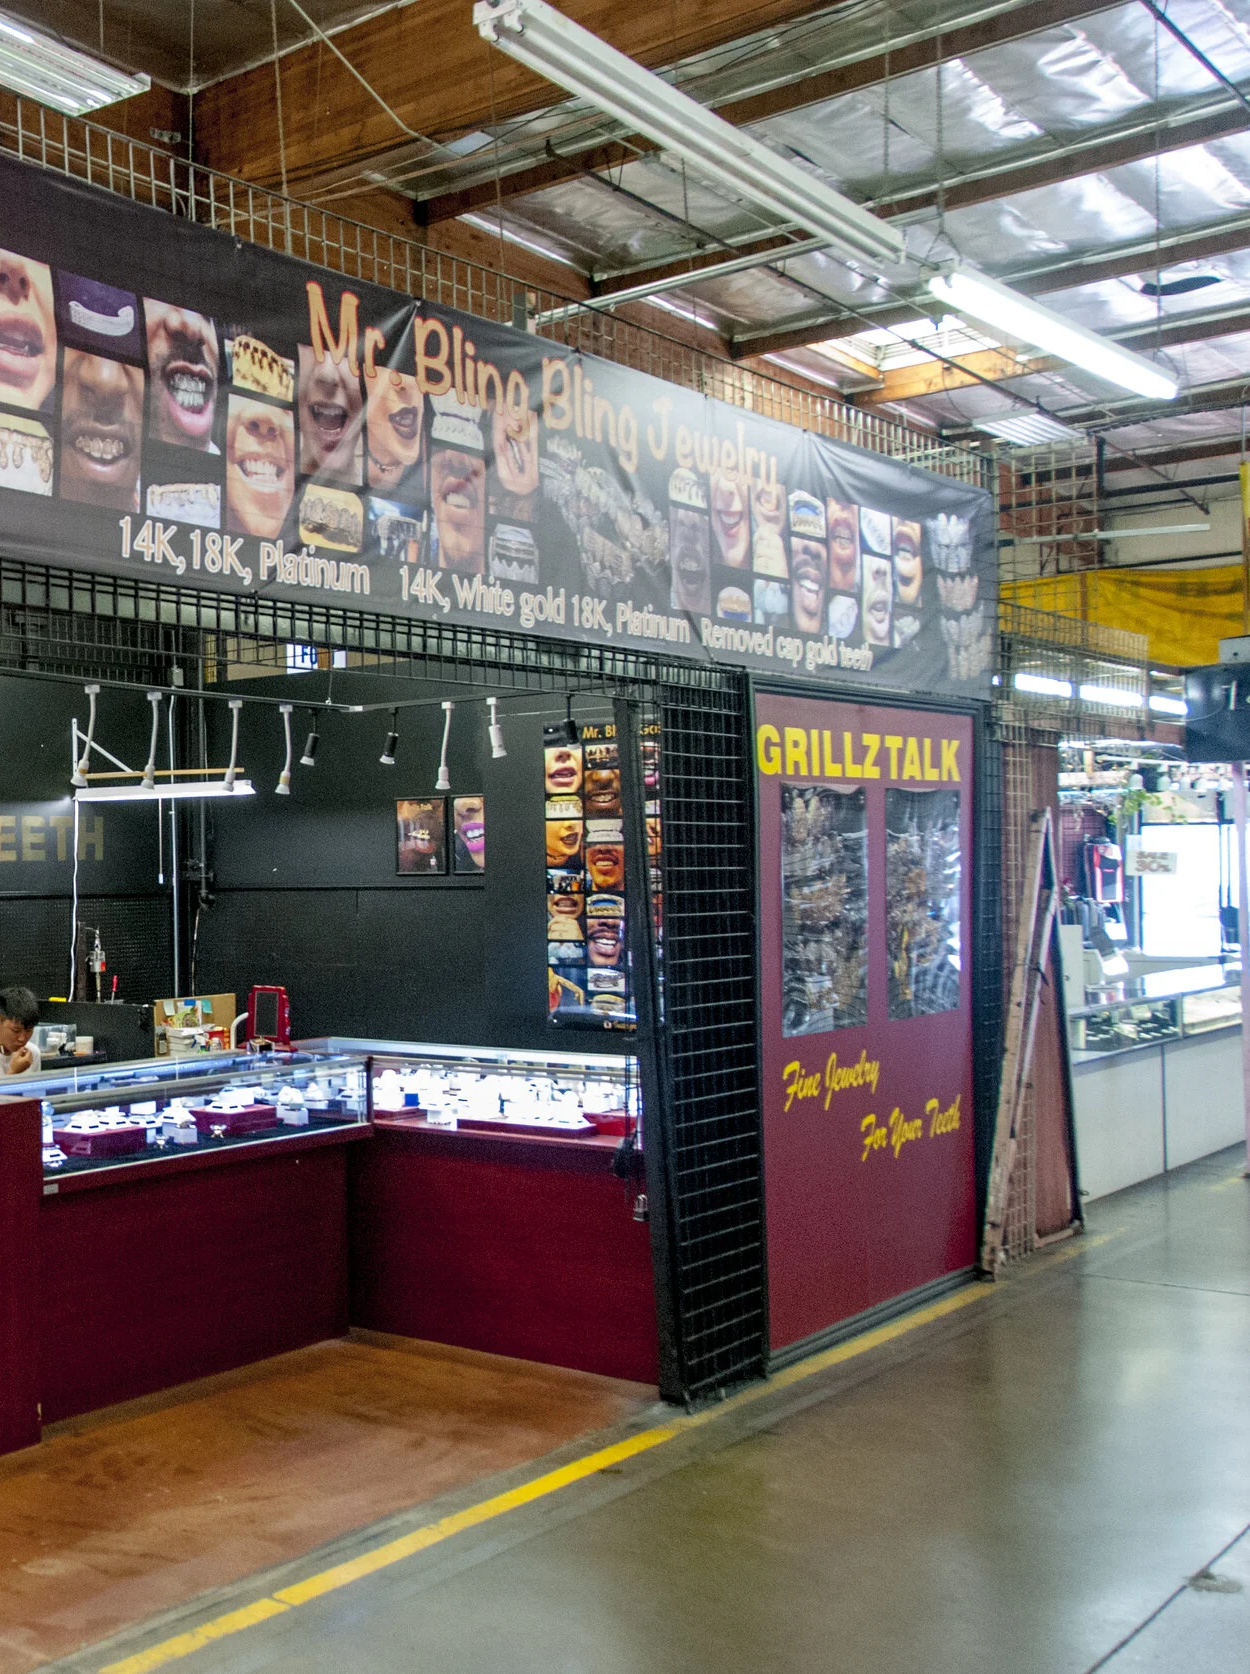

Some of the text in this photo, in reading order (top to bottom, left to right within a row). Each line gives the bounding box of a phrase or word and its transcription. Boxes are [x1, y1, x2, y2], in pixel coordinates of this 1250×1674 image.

[306, 280, 402, 386] Mr.
[414, 316, 530, 443] Bling
[542, 356, 639, 473] Bling
[260, 540, 371, 594] Platinum
[400, 565, 874, 671] 14K, White gold 18K, Platinum Removed cap gold teeth
[782, 1049, 879, 1112] Fine Jewelry
[860, 1094, 961, 1162] For Your Teeth
